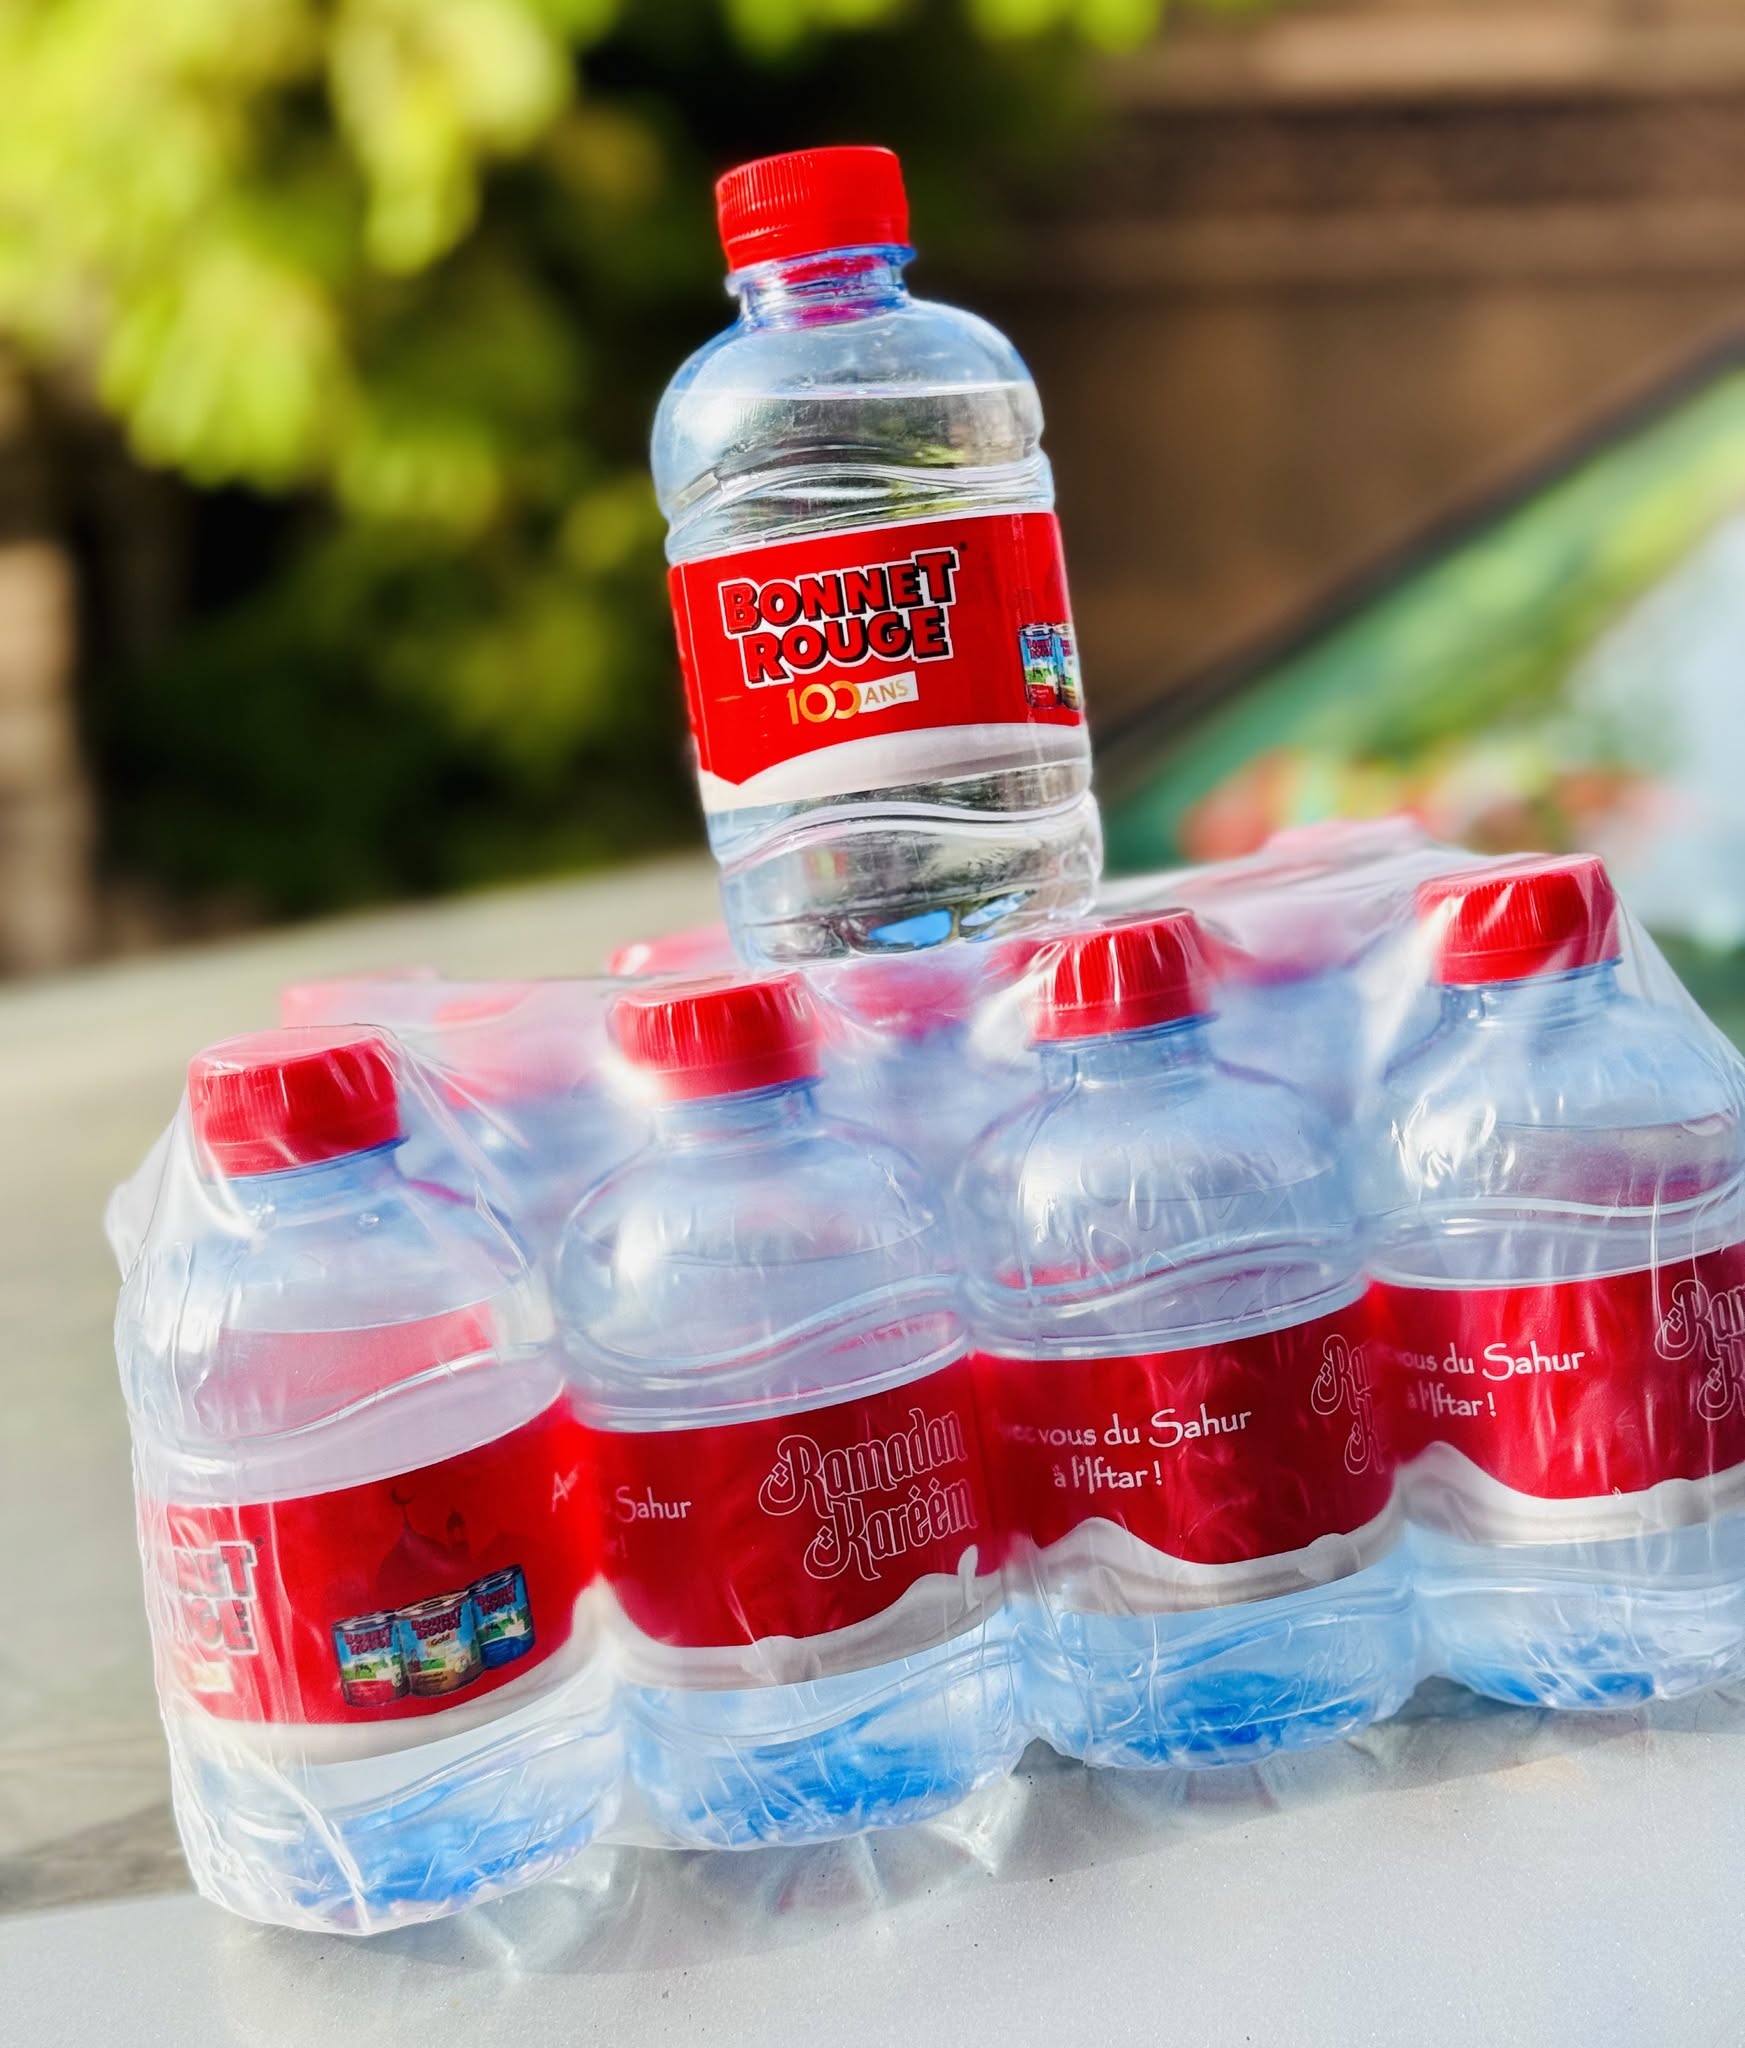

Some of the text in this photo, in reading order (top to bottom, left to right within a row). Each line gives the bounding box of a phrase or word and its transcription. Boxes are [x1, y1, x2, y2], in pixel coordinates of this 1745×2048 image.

[719, 548, 958, 634] BONNET
[741, 605, 953, 687] ROUGE
[786, 679, 909, 725] 100 ANS
[1443, 1342, 1475, 1374] du
[1482, 1340, 1586, 1381] Sahur
[1038, 1428, 1097, 1446] vous
[1104, 1413, 1141, 1446] du
[1149, 1403, 1252, 1448] Sahur
[758, 1408, 968, 1519] Ramadan
[615, 1486, 692, 1523] Sahur
